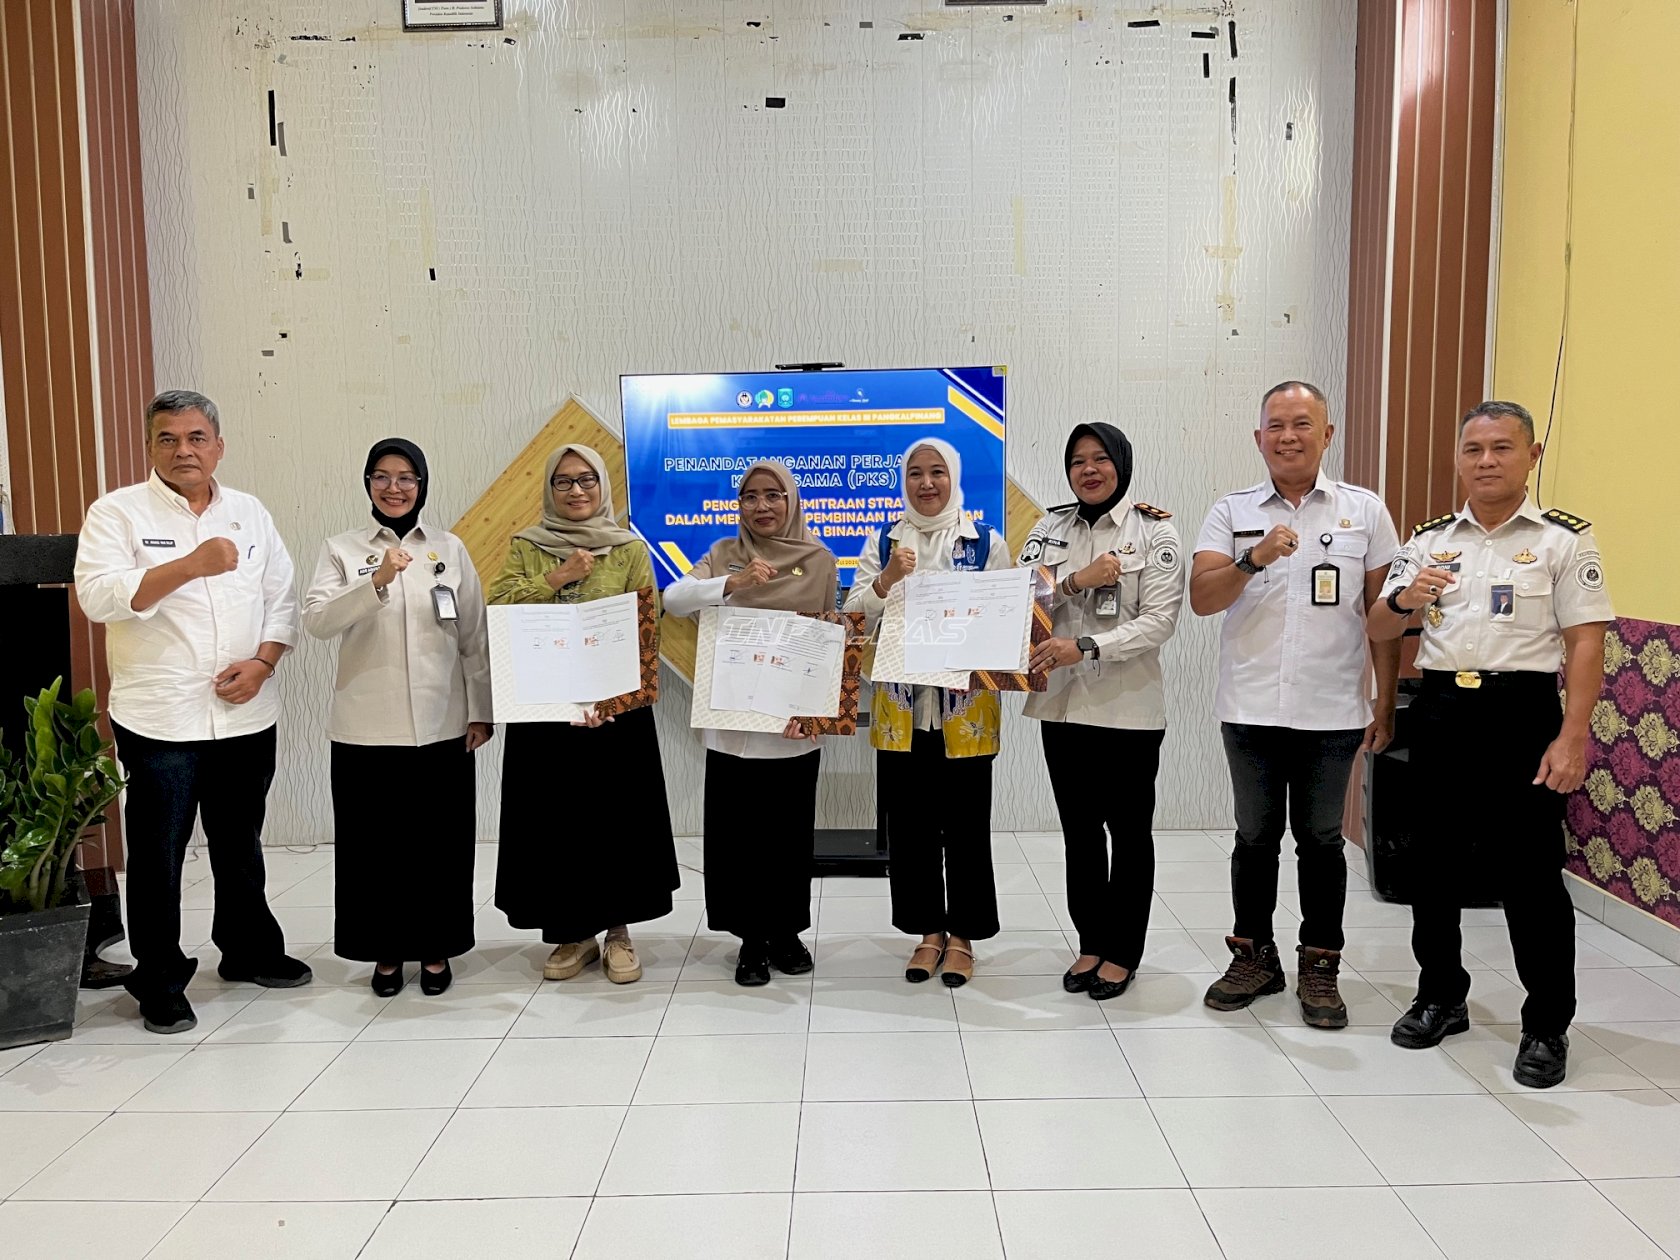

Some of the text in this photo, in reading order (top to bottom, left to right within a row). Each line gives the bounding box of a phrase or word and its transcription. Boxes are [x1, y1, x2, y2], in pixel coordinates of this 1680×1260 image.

[671, 417, 709, 425] LEMBAGA
[710, 415, 786, 425] PEMASYARAKATAN
[788, 414, 836, 423] PEREMPUAN
[837, 413, 862, 422] KELAS
[872, 411, 942, 421] PANGKALPINANG
[847, 469, 898, 490] (PKS)
[665, 513, 713, 526] DALAM
[804, 511, 885, 524] PEMBINAAN
[823, 525, 875, 537] BINAAN
